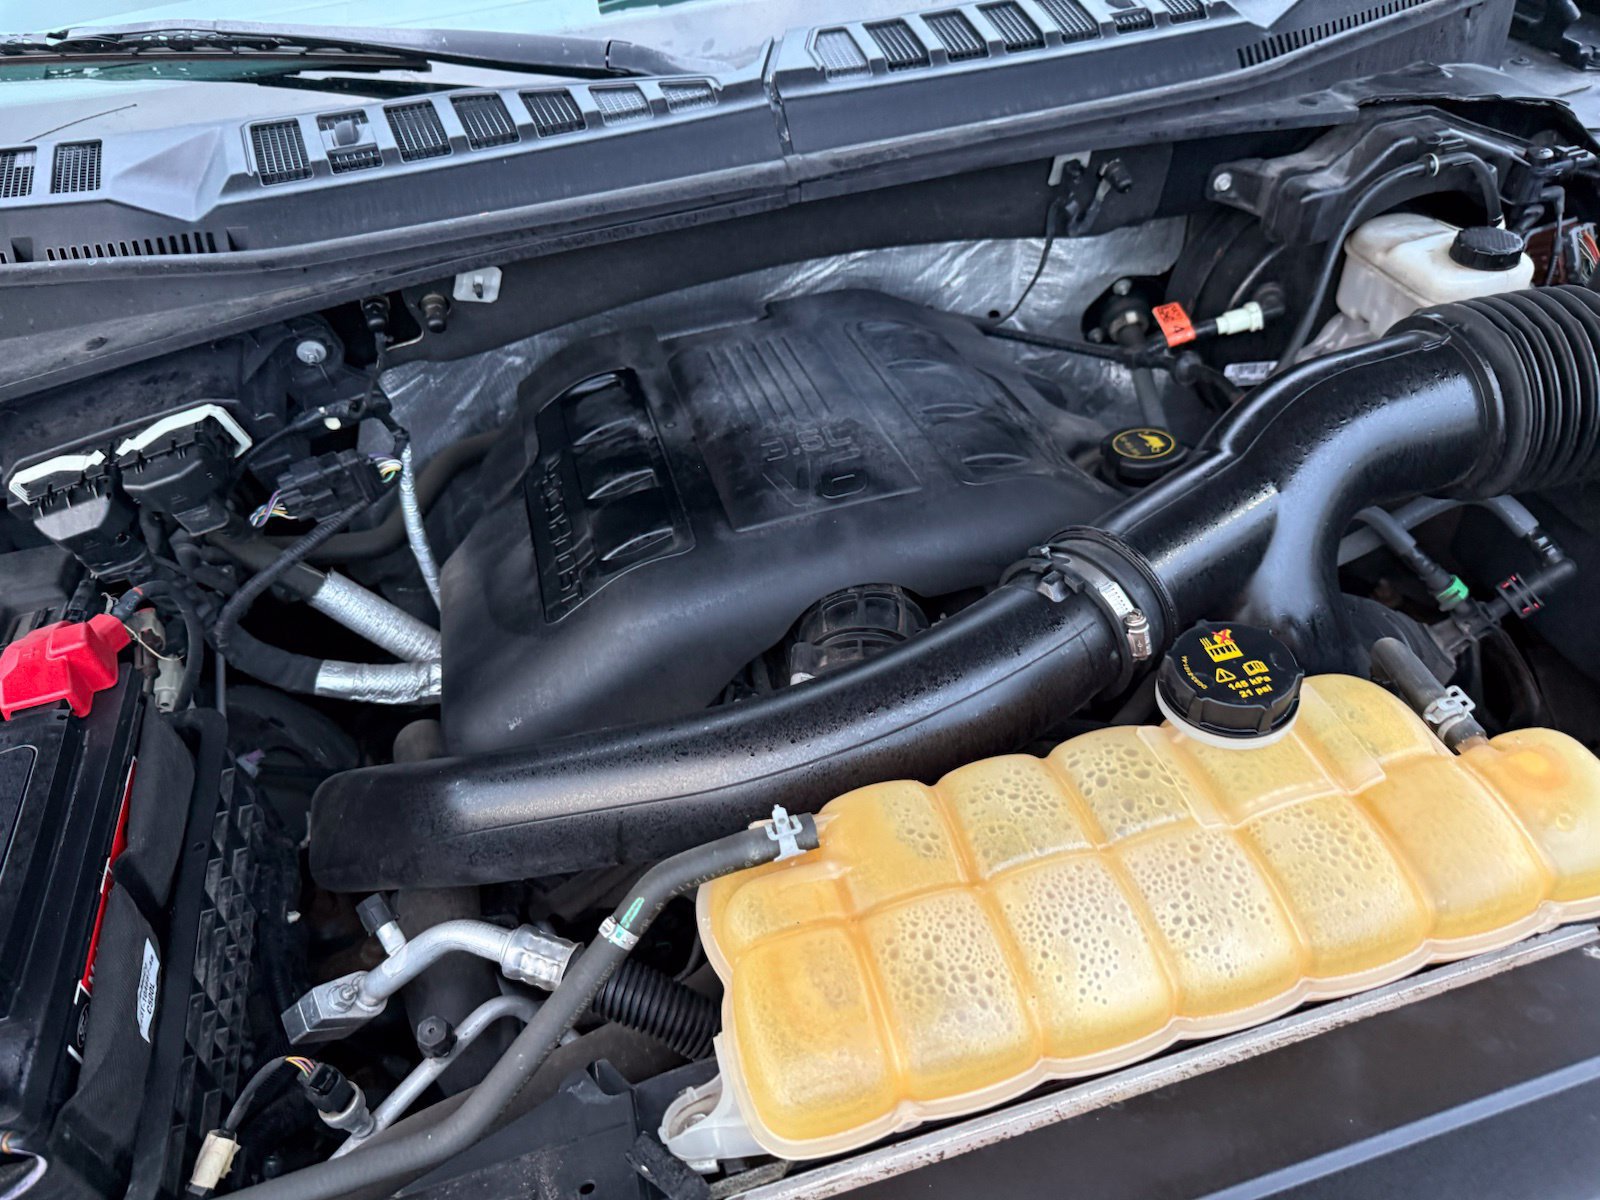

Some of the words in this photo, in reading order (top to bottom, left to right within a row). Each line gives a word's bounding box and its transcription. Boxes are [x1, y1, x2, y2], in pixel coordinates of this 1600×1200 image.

[760, 426, 853, 462] 3.5L
[761, 447, 870, 508] V6
[1239, 689, 1253, 698] 21
[1255, 684, 1273, 695] psi
[1249, 676, 1272, 685] kPa
